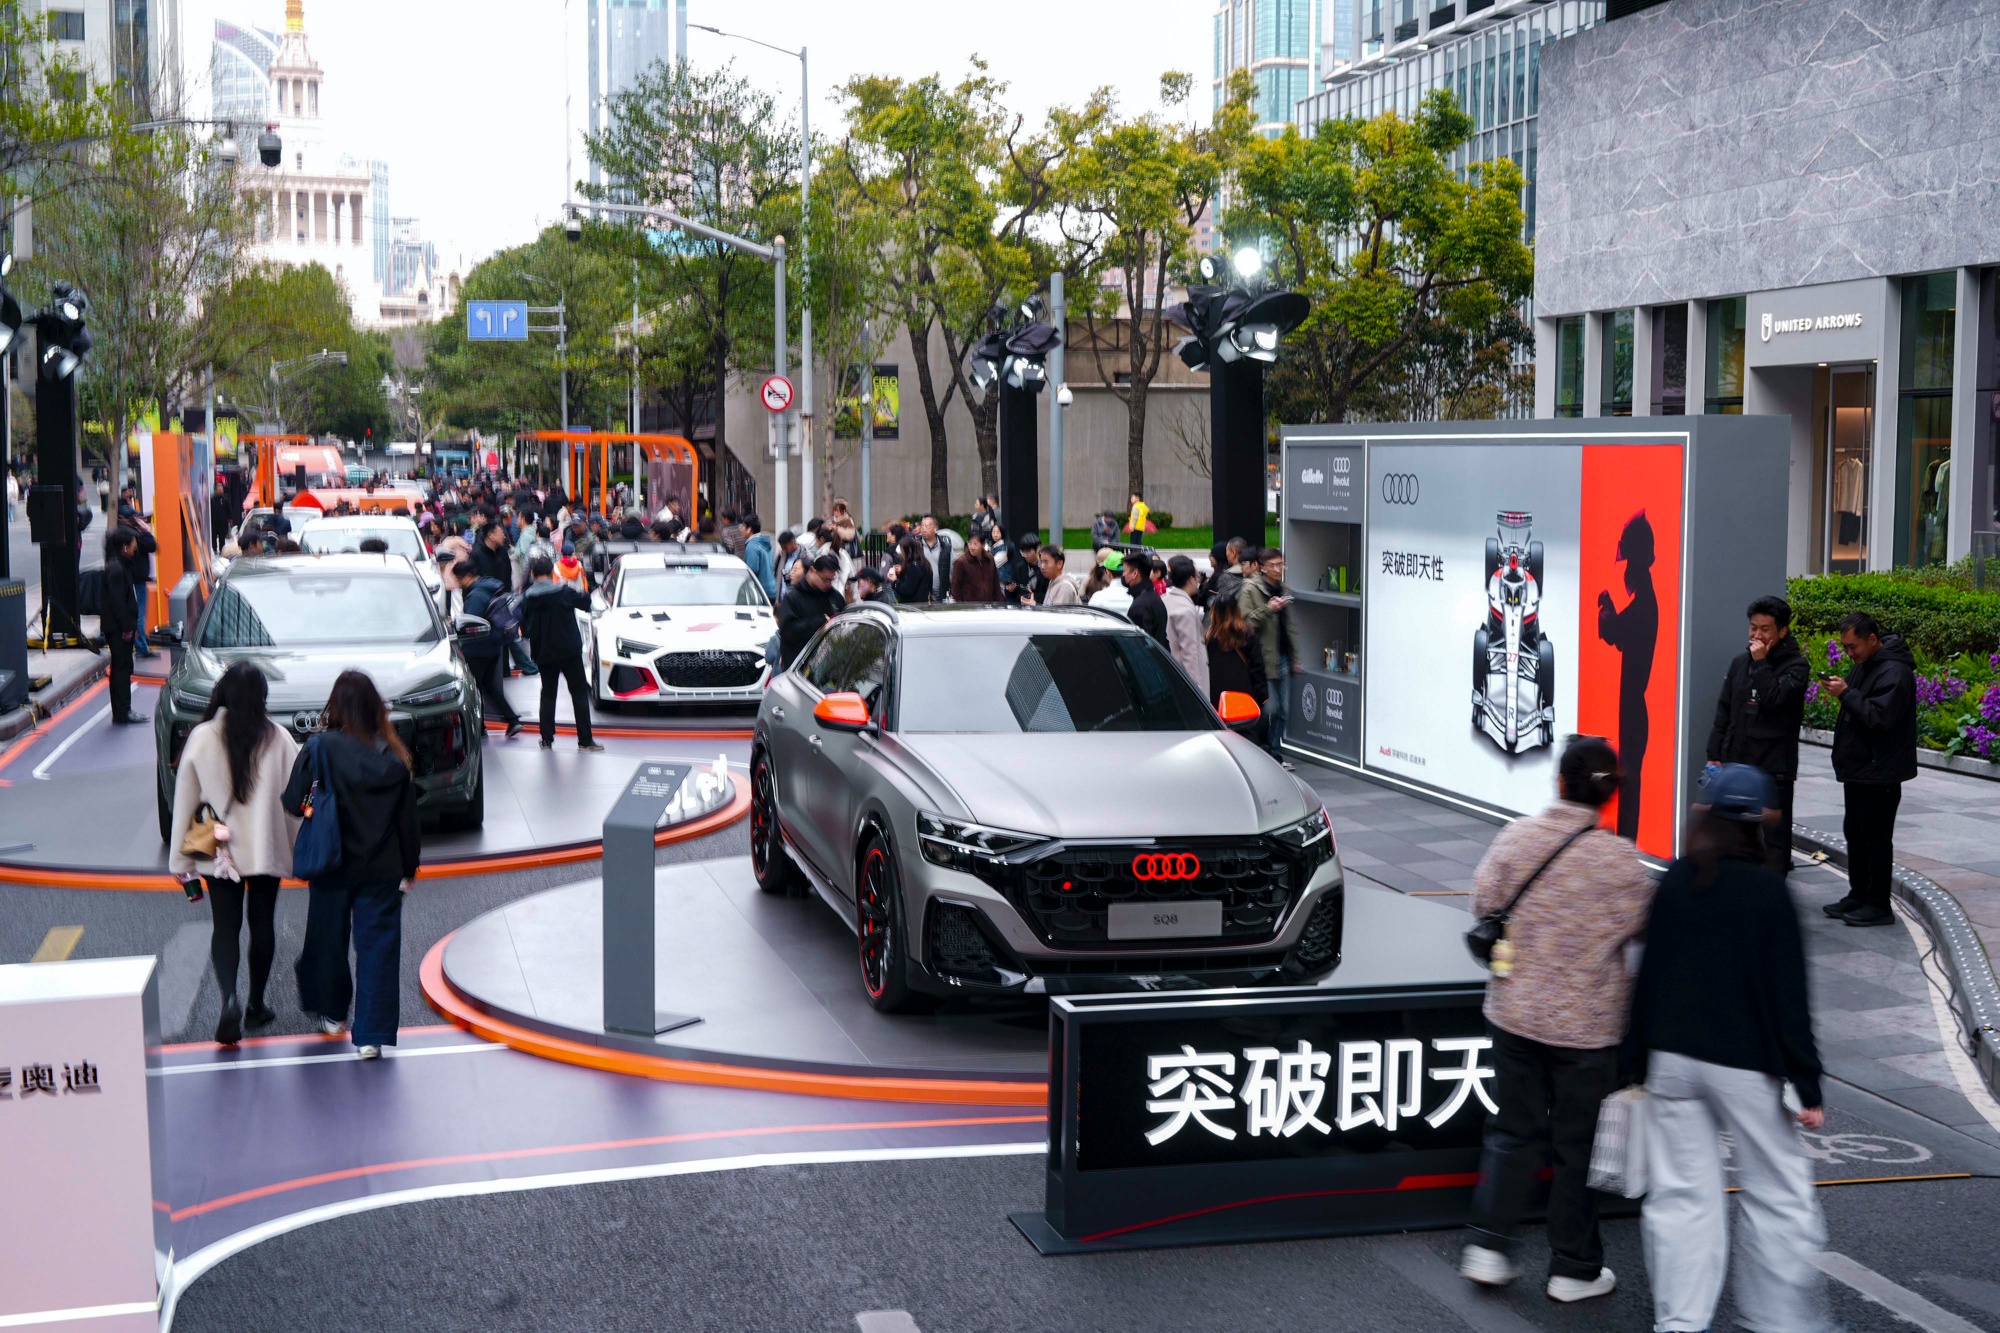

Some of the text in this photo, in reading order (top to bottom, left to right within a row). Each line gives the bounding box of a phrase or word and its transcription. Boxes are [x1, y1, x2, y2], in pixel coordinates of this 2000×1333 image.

[1774, 313, 1862, 333] UNITED ARROWS
[1301, 468, 1324, 484] Gillette
[1382, 550, 1443, 581] 突破即天性
[1507, 652, 1518, 662] 27
[1153, 914, 1178, 926] SQ8
[1144, 1036, 1500, 1146] 突破即天
